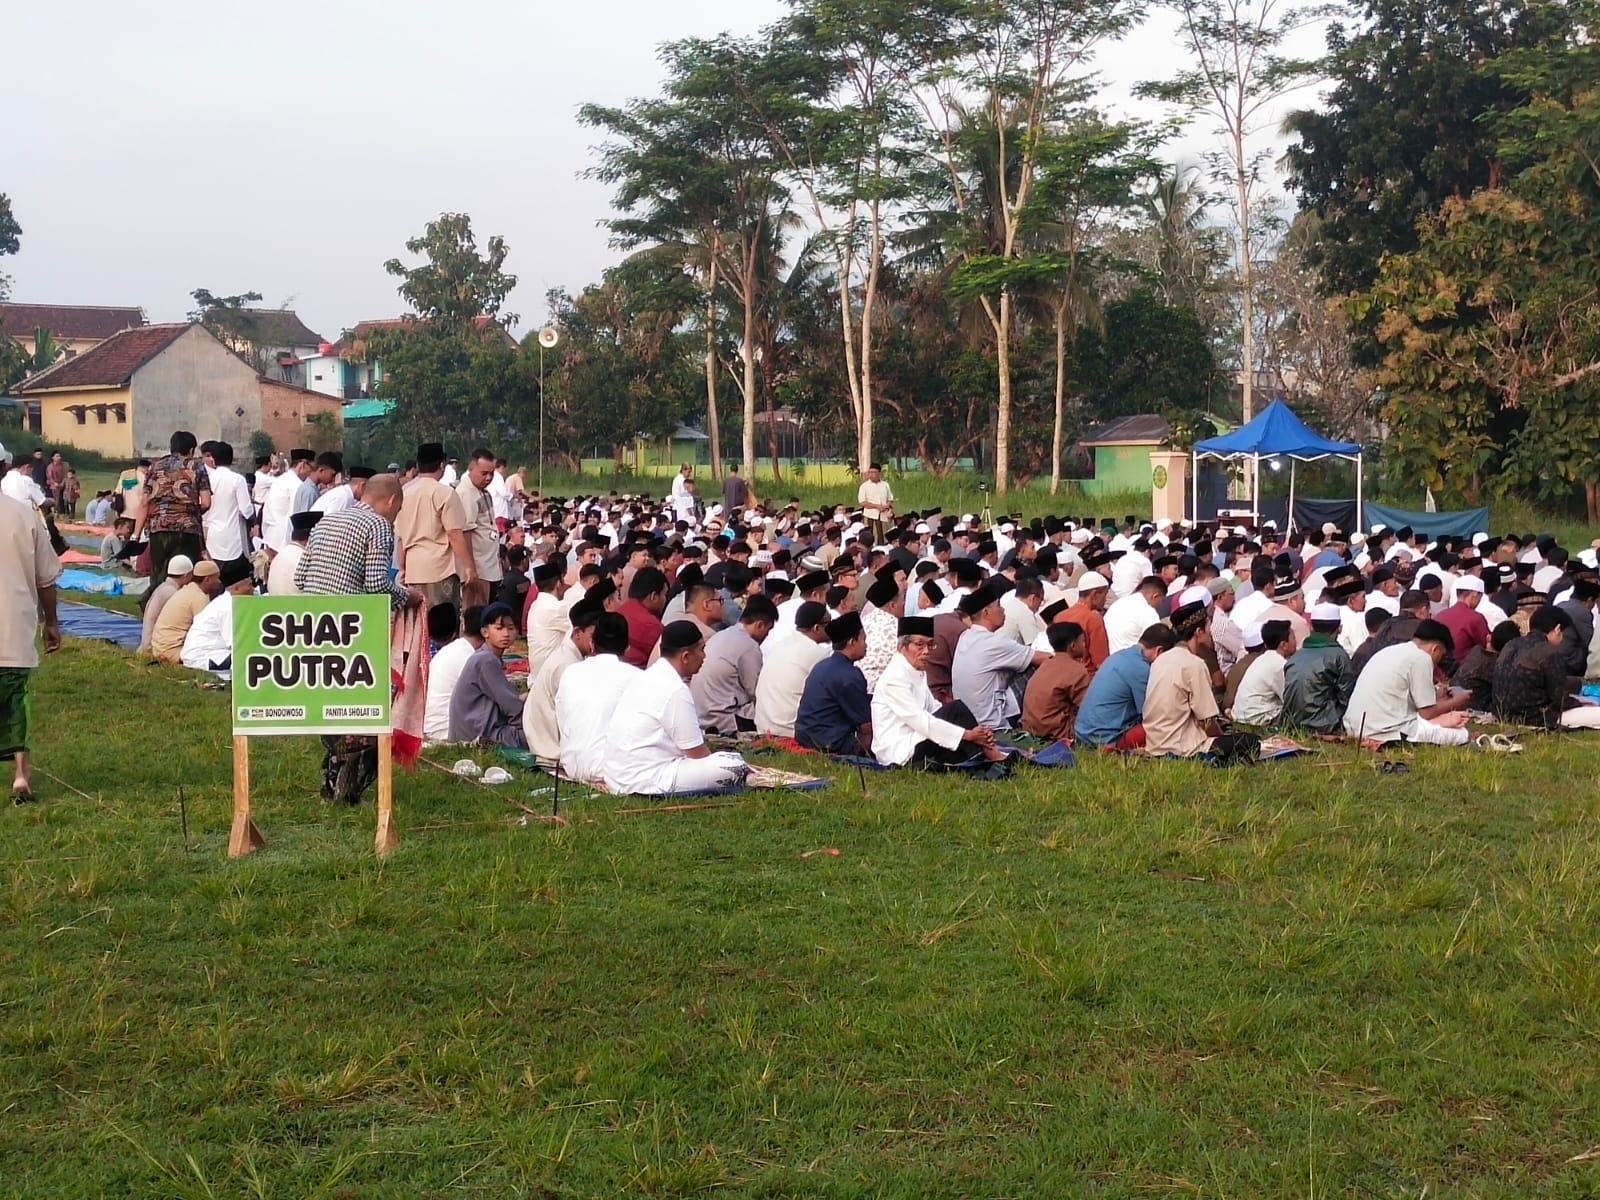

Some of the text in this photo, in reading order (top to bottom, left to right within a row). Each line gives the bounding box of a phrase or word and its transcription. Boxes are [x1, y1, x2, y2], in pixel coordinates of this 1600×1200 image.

[261, 613, 361, 648] SHAF
[247, 654, 374, 688] PUTRA
[265, 708, 303, 717] BONDOWOSO
[326, 707, 347, 716] PANITIA
[349, 707, 369, 716] SHOLAT
